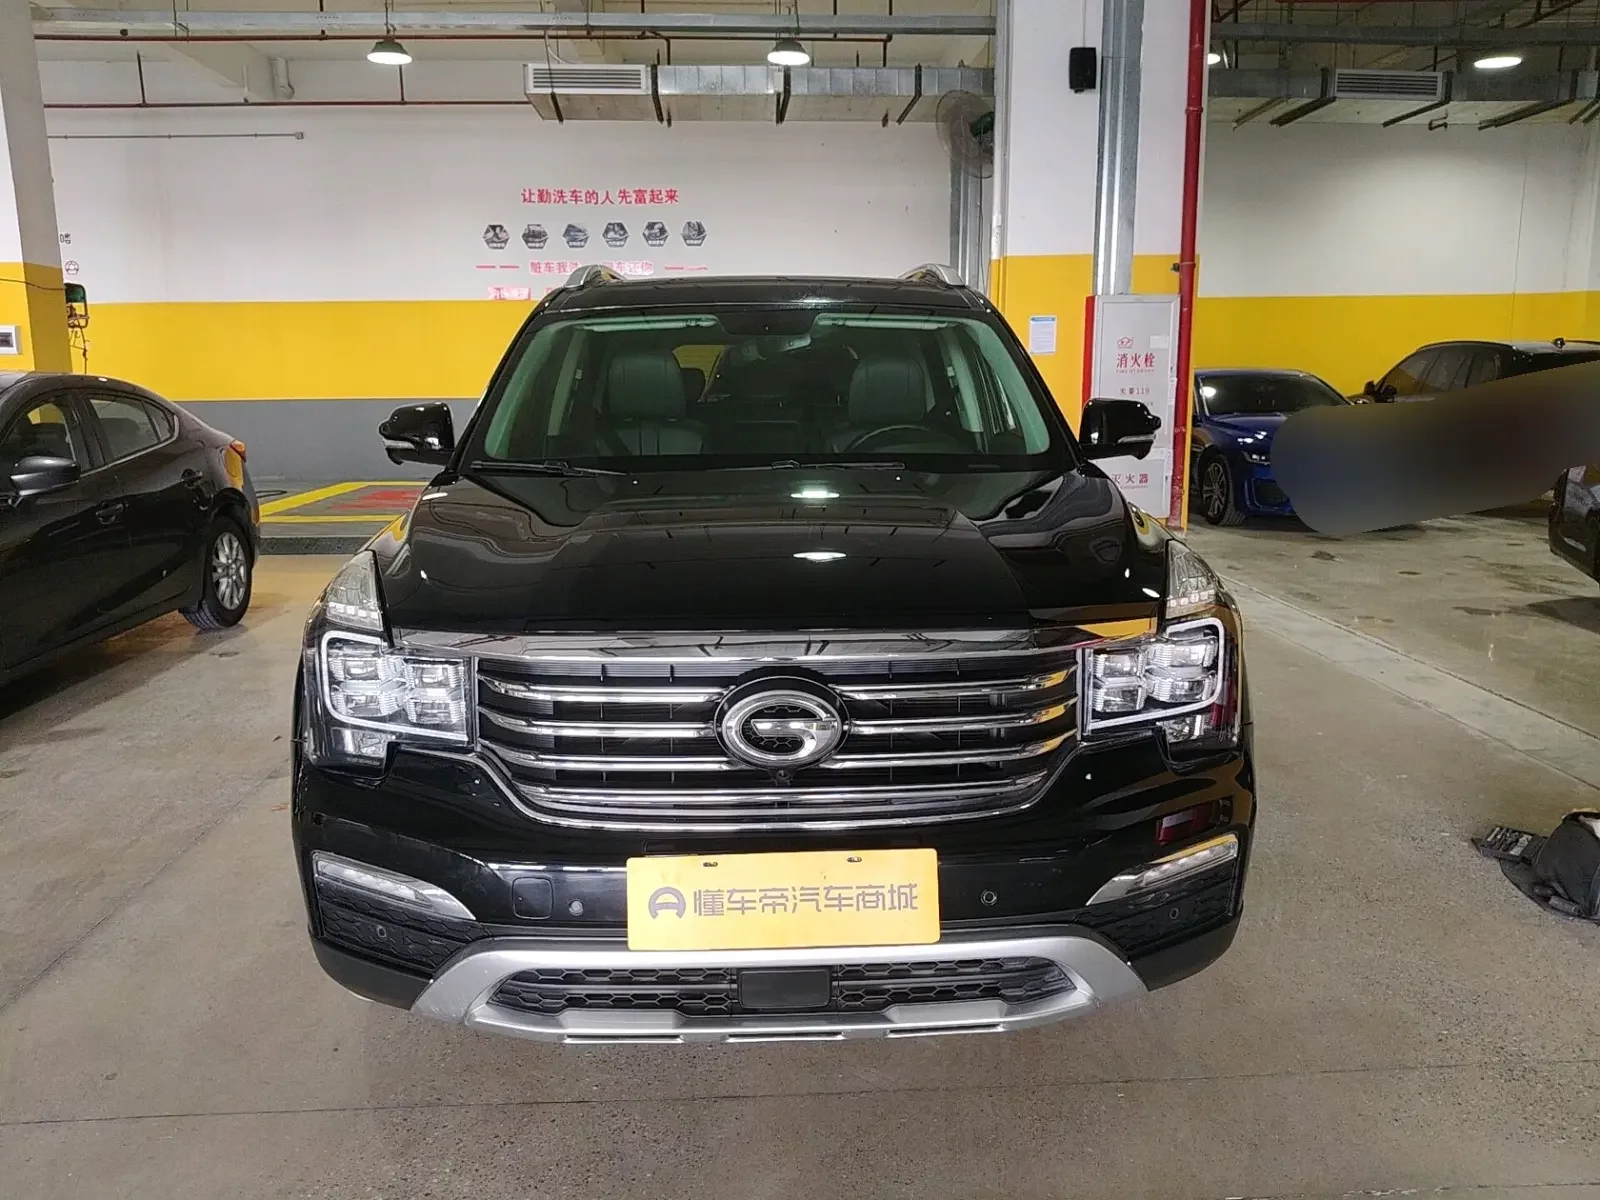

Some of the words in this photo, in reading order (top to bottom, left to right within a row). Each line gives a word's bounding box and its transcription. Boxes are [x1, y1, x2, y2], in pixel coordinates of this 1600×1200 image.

[521, 188, 679, 205] 让勤洗车的人先富起来
[1116, 352, 1156, 368] 消火栓
[1112, 473, 1148, 484] 灭火器
[693, 882, 919, 917] 懂车帝汽车商城
